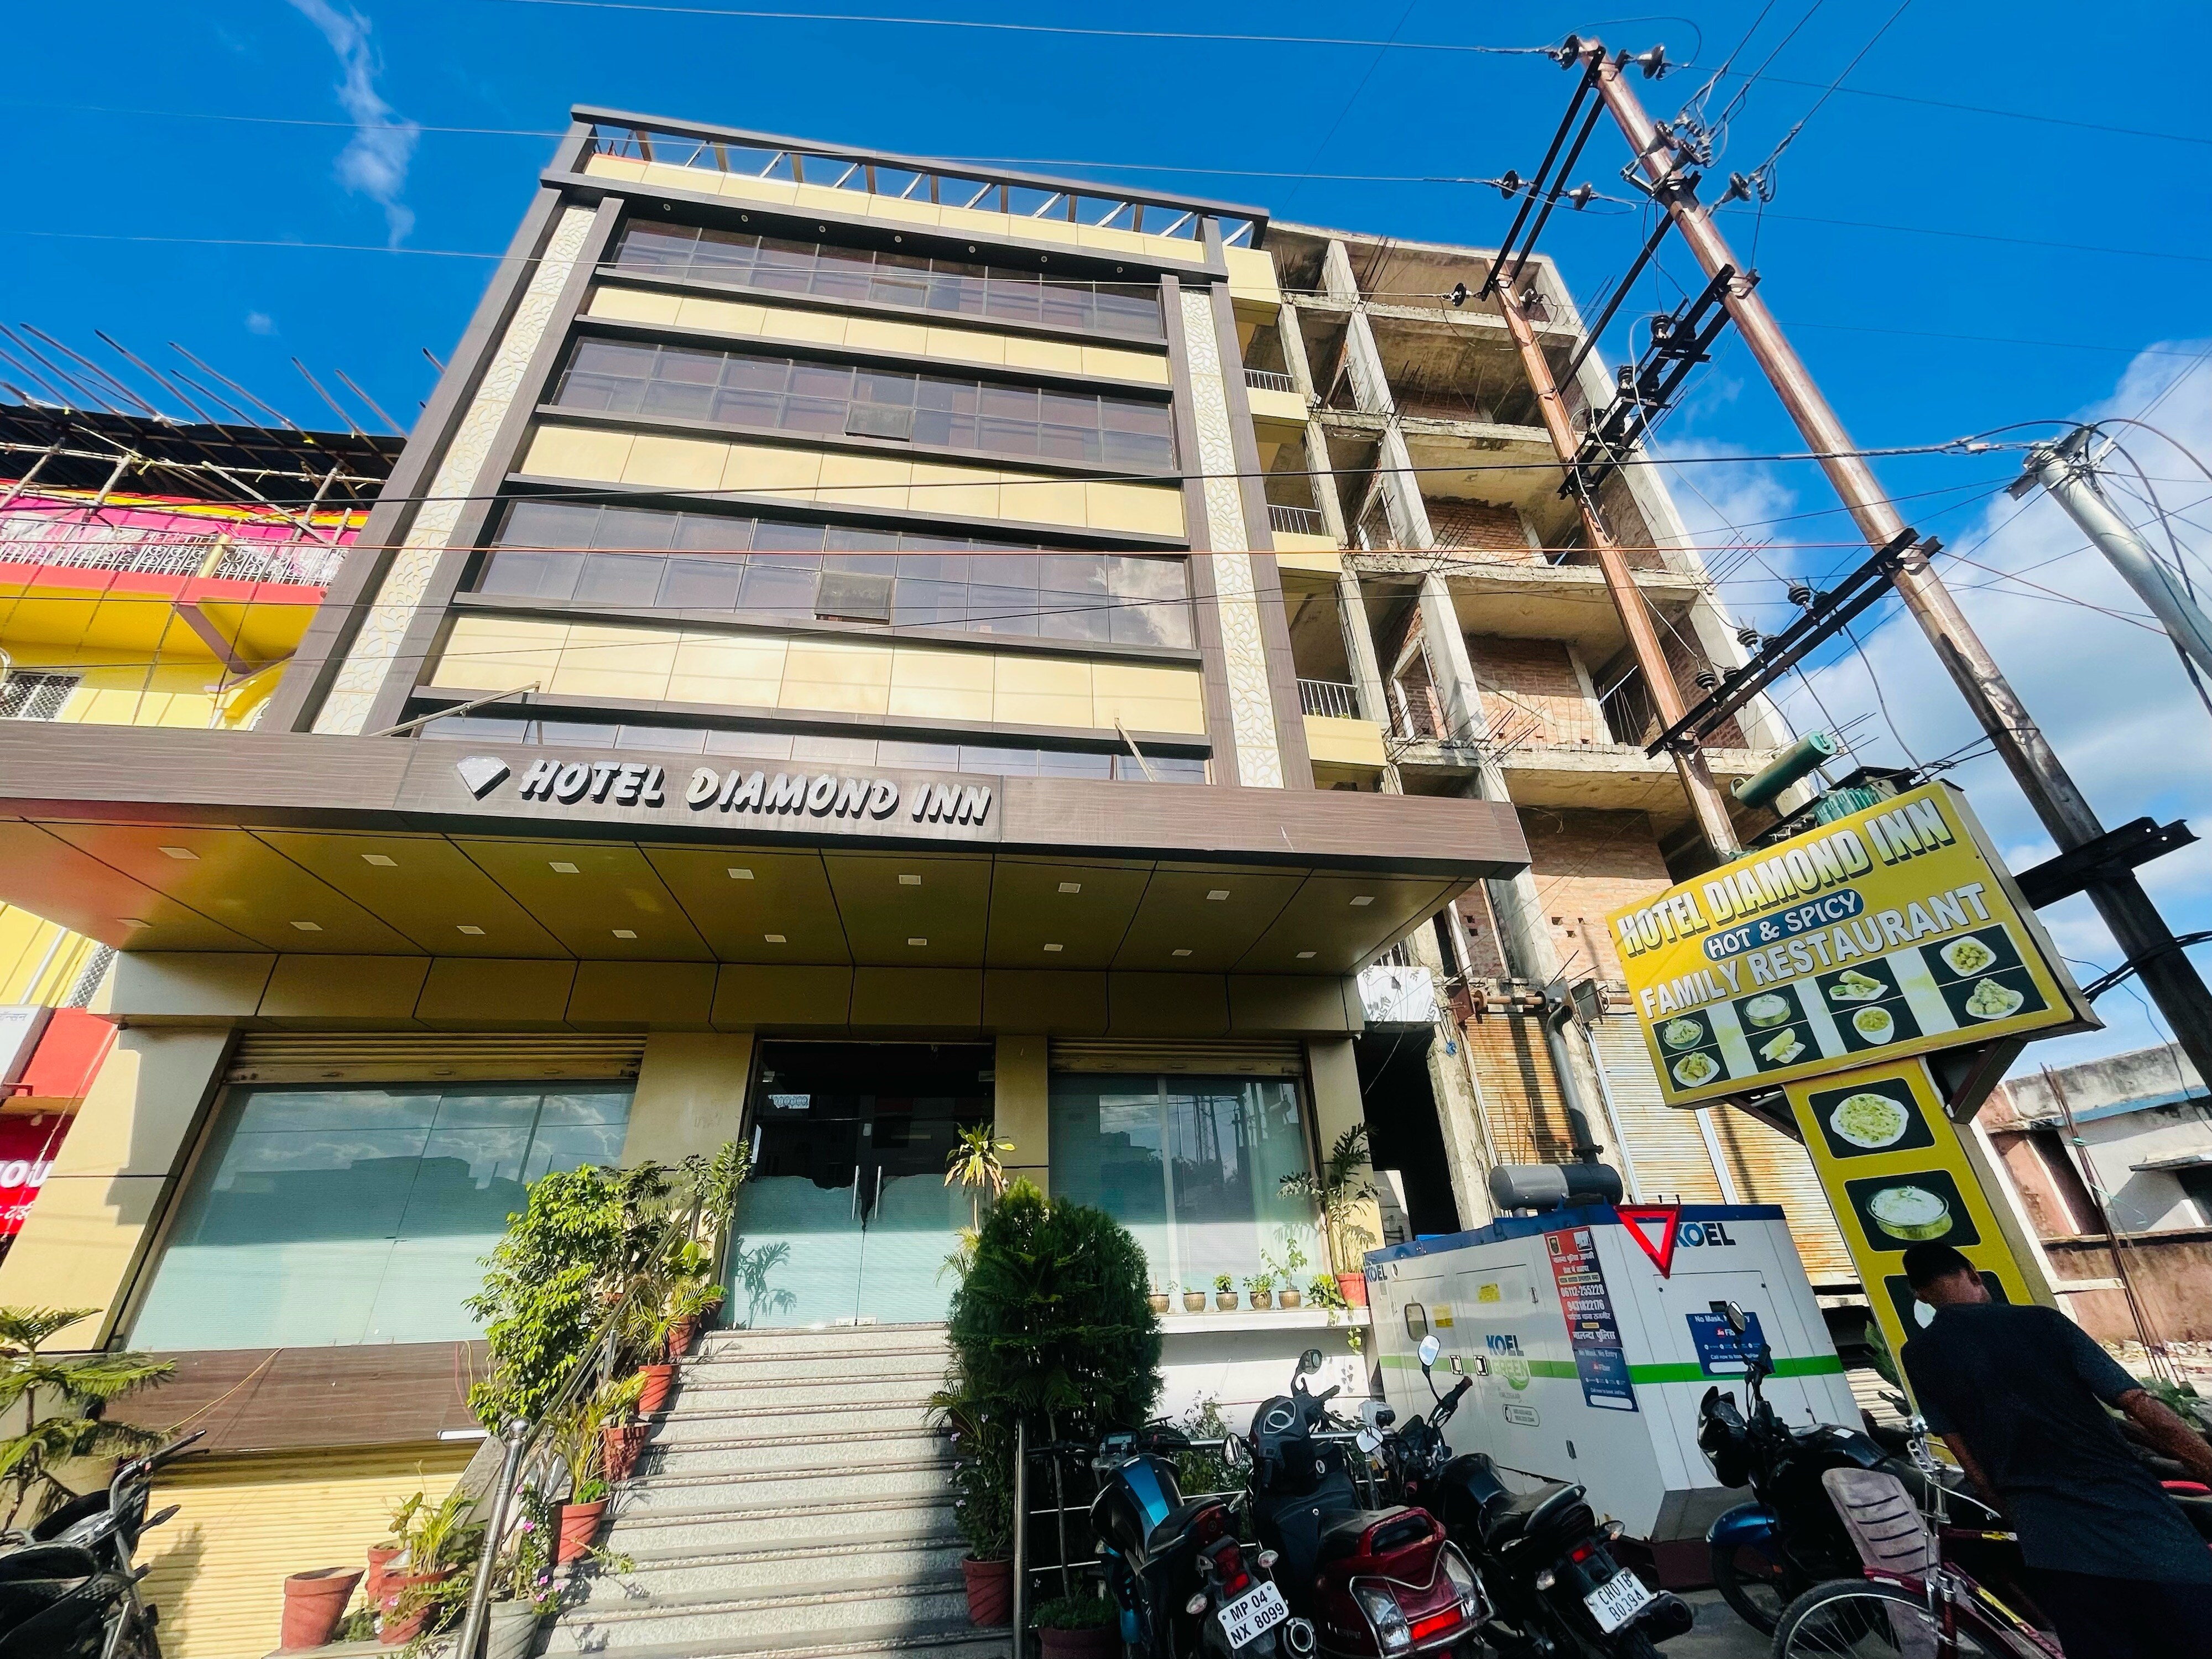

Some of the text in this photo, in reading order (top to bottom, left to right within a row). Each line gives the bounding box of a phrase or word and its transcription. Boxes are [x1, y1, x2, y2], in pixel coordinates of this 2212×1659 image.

[518, 758, 992, 826] HOTEL DIAMOND INN
[1617, 797, 1957, 958] HOTEL DIAMOND INN
[1707, 891, 1859, 959] HOT & SPICY
[1640, 882, 1991, 1019] FAMILY RESTAURANT
[1560, 1284, 1605, 1297] 06112-255228
[1705, 1314, 1724, 1323] Mask,
[1485, 1334, 1525, 1357] KOEL
[1605, 1350, 1618, 1359] Entry
[1491, 1359, 1530, 1378] GREEN
[1598, 1572, 1634, 1605] CH01B
[1229, 1590, 1268, 1622] MP 04
[1230, 1601, 1285, 1645] NX 8099
